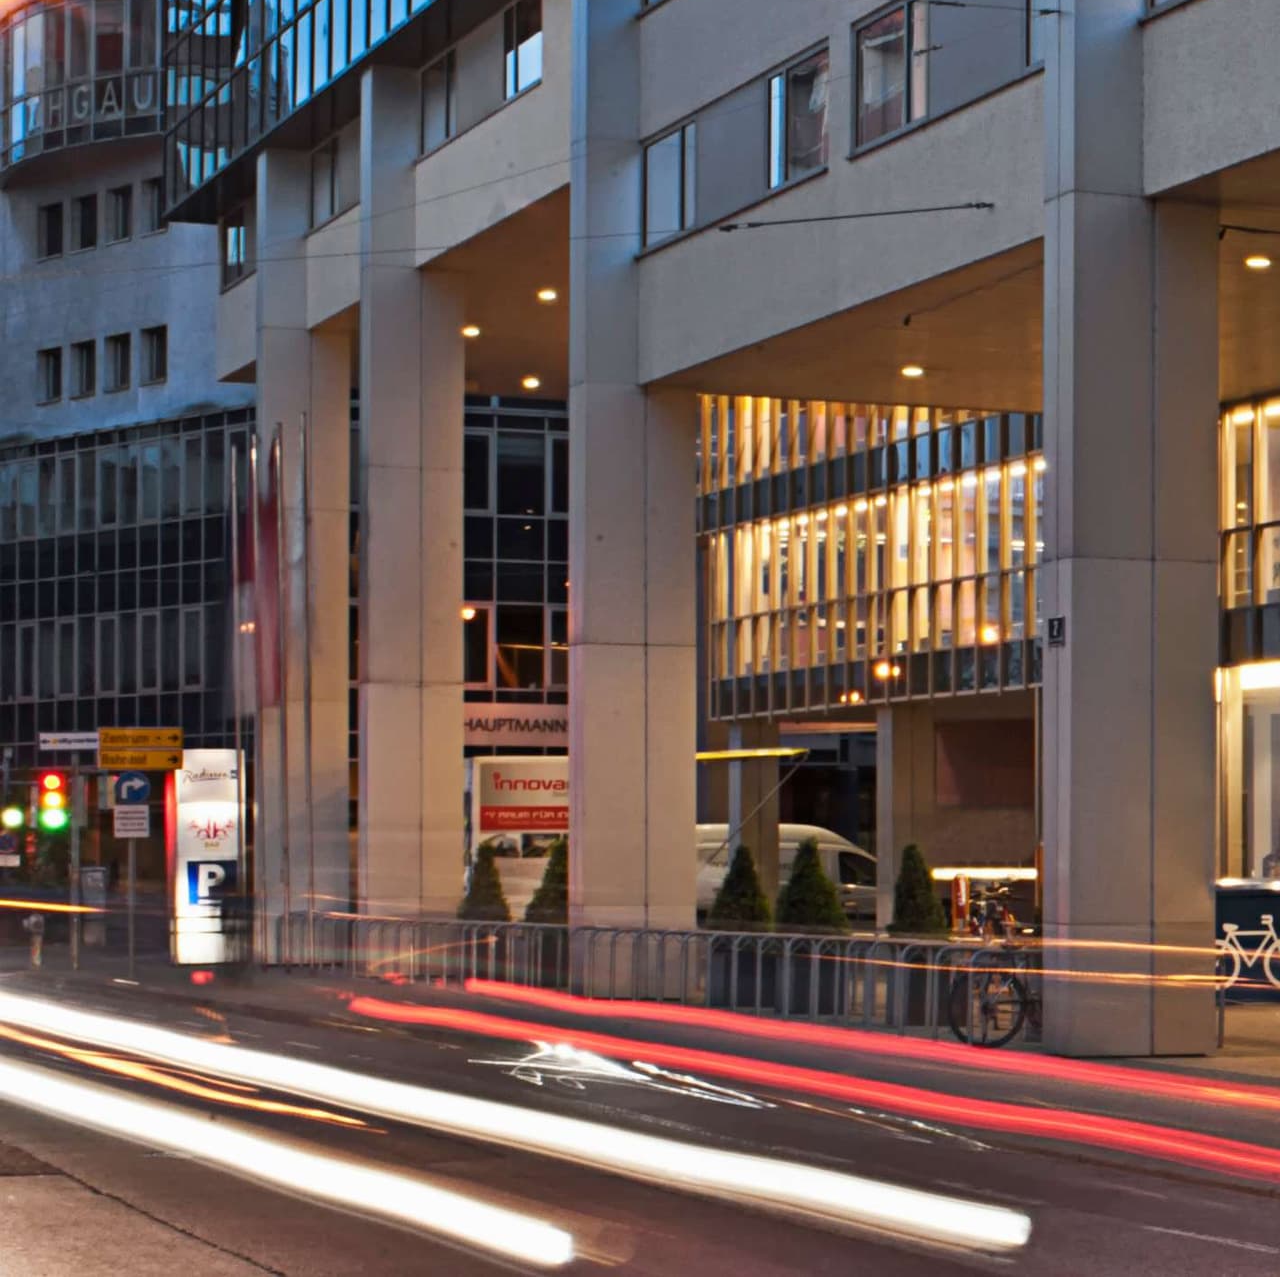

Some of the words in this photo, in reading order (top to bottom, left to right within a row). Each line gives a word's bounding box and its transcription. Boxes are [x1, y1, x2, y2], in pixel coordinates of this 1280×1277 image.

[464, 718, 569, 733] HAUPTMANN
[182, 768, 229, 785] Radisson
[493, 771, 569, 791] innova
[197, 863, 226, 898] P
